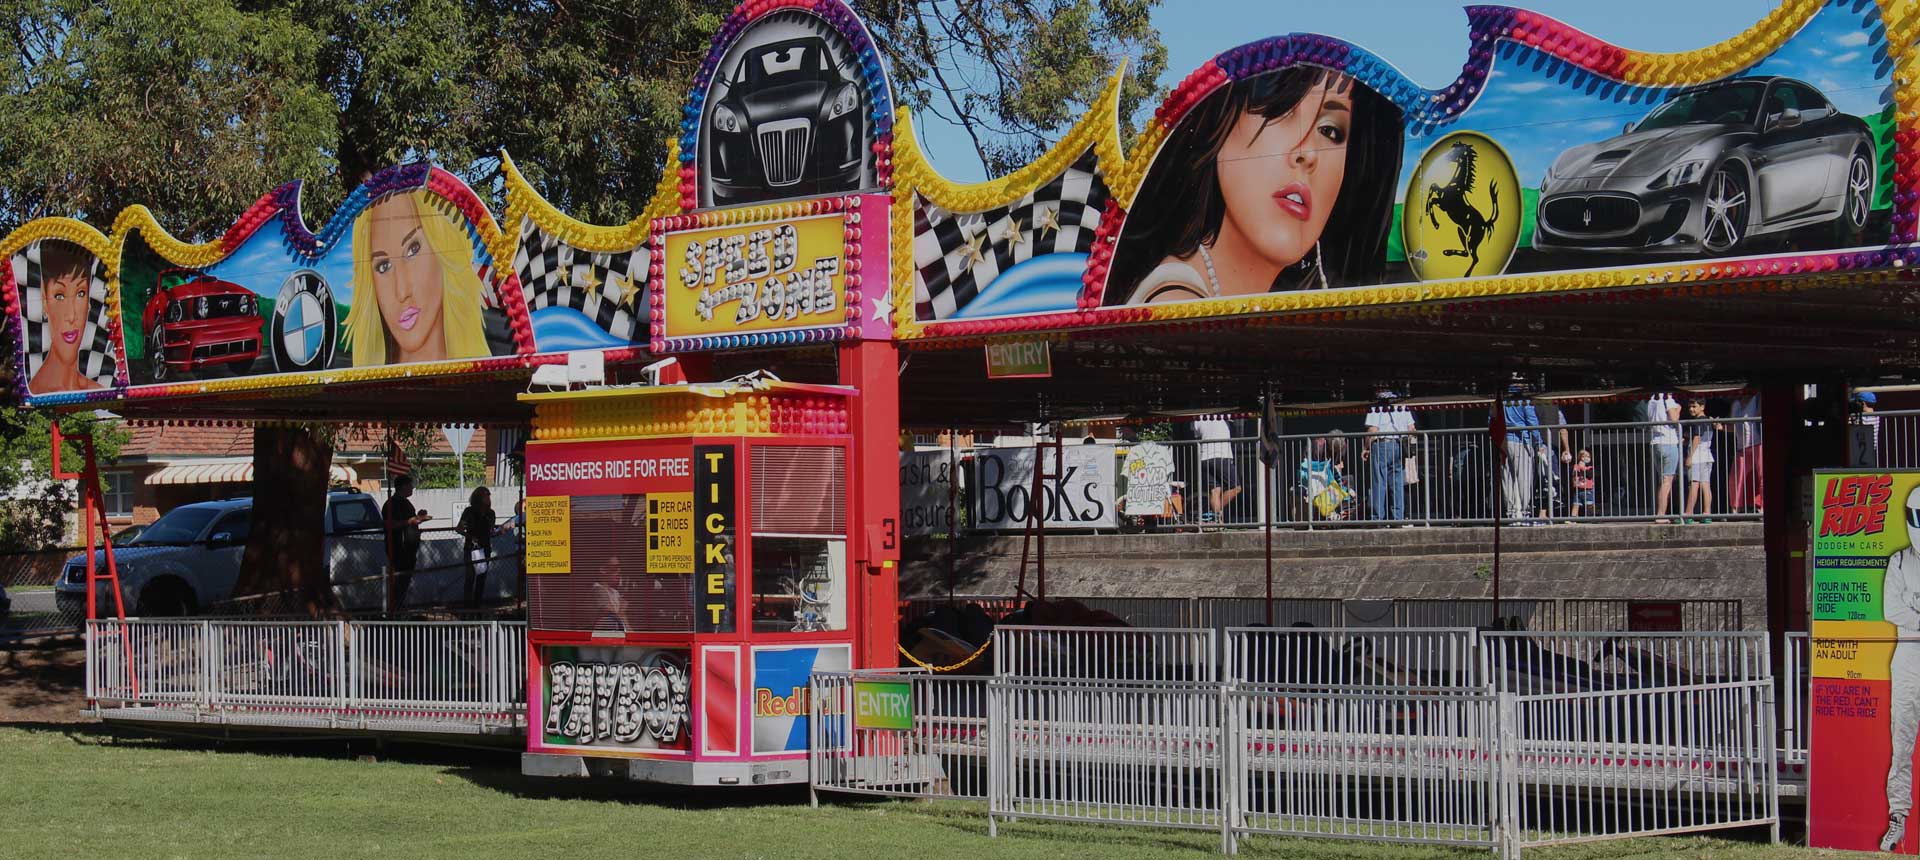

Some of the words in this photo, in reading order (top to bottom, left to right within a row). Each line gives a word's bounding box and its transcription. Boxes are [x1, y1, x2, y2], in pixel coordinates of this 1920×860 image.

[680, 224, 798, 288] SPEED
[277, 275, 329, 317] BMW
[696, 256, 838, 324] ZONE
[990, 341, 1044, 368] ENTRY
[530, 462, 603, 481] PASSENGERS
[605, 460, 632, 479] RIDE
[634, 459, 657, 478] FOR
[659, 458, 689, 477] FREE
[1127, 484, 1167, 502] CLOTHES
[1823, 474, 1893, 509] LETS
[660, 501, 675, 513] PER
[677, 501, 692, 513] CAR
[660, 518, 665, 530] 2
[667, 518, 688, 530] RIDES
[900, 504, 956, 529] asure
[1819, 503, 1888, 538] RIDE
[661, 536, 675, 547] FOR
[677, 536, 682, 547] 3
[705, 453, 726, 625] TICKET
[882, 519, 896, 550] 3
[1817, 541, 1855, 550] DODGEM
[1860, 541, 1885, 550] CARS
[1816, 558, 1839, 567] HEIGHT
[1840, 558, 1888, 567] REQUIREMENTS
[1816, 582, 1838, 592] YOUR
[1840, 582, 1850, 592] IN
[1851, 582, 1868, 592] THE
[1816, 592, 1845, 602] GREEN
[1846, 593, 1859, 603] OK
[1860, 593, 1872, 603] TO
[1816, 603, 1837, 613] RIDE
[1816, 638, 1836, 649] RIDE
[1837, 639, 1859, 649] WITH
[1816, 650, 1828, 659] AN
[1830, 650, 1857, 660] ADULT
[1816, 685, 1824, 694] IF
[1825, 684, 1841, 695] YOU
[1843, 685, 1860, 695] ARE
[1862, 686, 1871, 696] IN
[546, 659, 692, 744] PAYBOX
[755, 686, 801, 717] Red
[859, 690, 910, 719] ENTRY
[1816, 695, 1831, 705] THE
[1815, 706, 1834, 716] RIDE
[1836, 707, 1855, 717] THIS
[1856, 708, 1877, 718] RIDE
